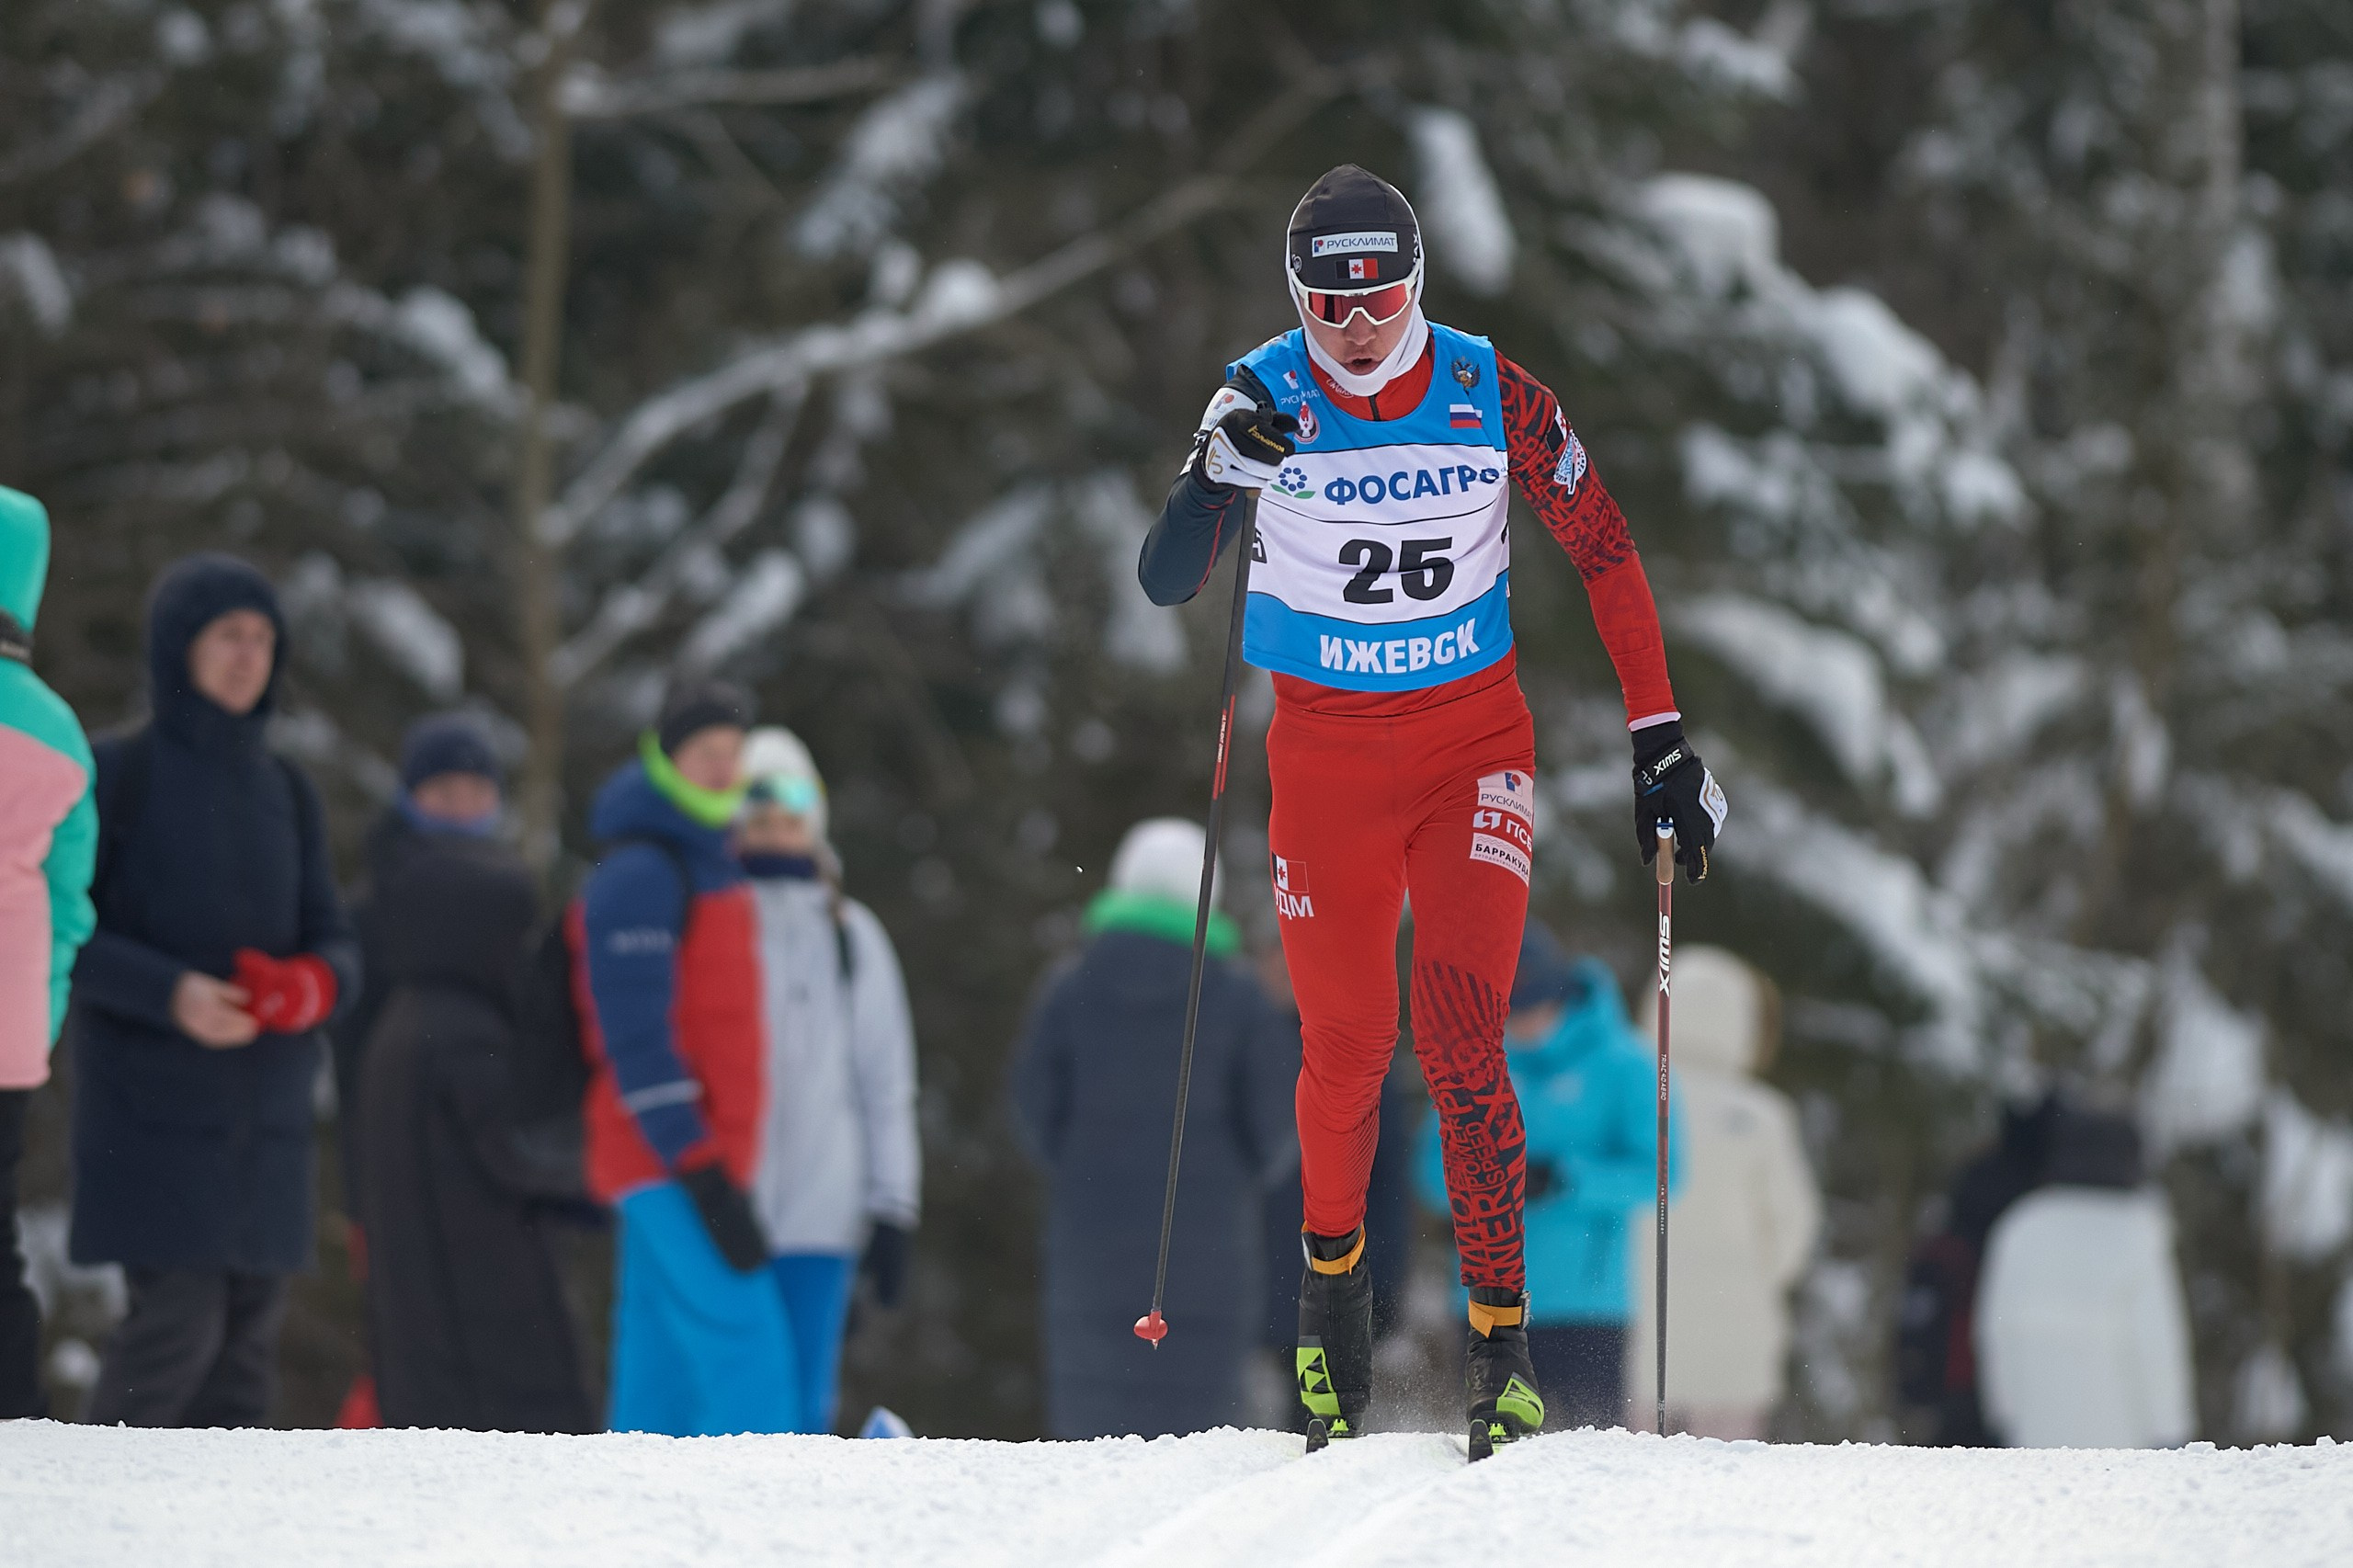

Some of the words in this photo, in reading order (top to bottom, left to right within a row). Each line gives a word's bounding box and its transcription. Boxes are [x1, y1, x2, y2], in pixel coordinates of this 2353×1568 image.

[1327, 237, 1395, 249] РУСКЛИМАТ
[1324, 464, 1500, 506] ФОСАГРО
[1338, 536, 1455, 605] 25
[1320, 618, 1480, 674] ИЖЕВСК
[1506, 819, 1532, 853] ПСБ
[1659, 911, 1670, 997] SWIX
